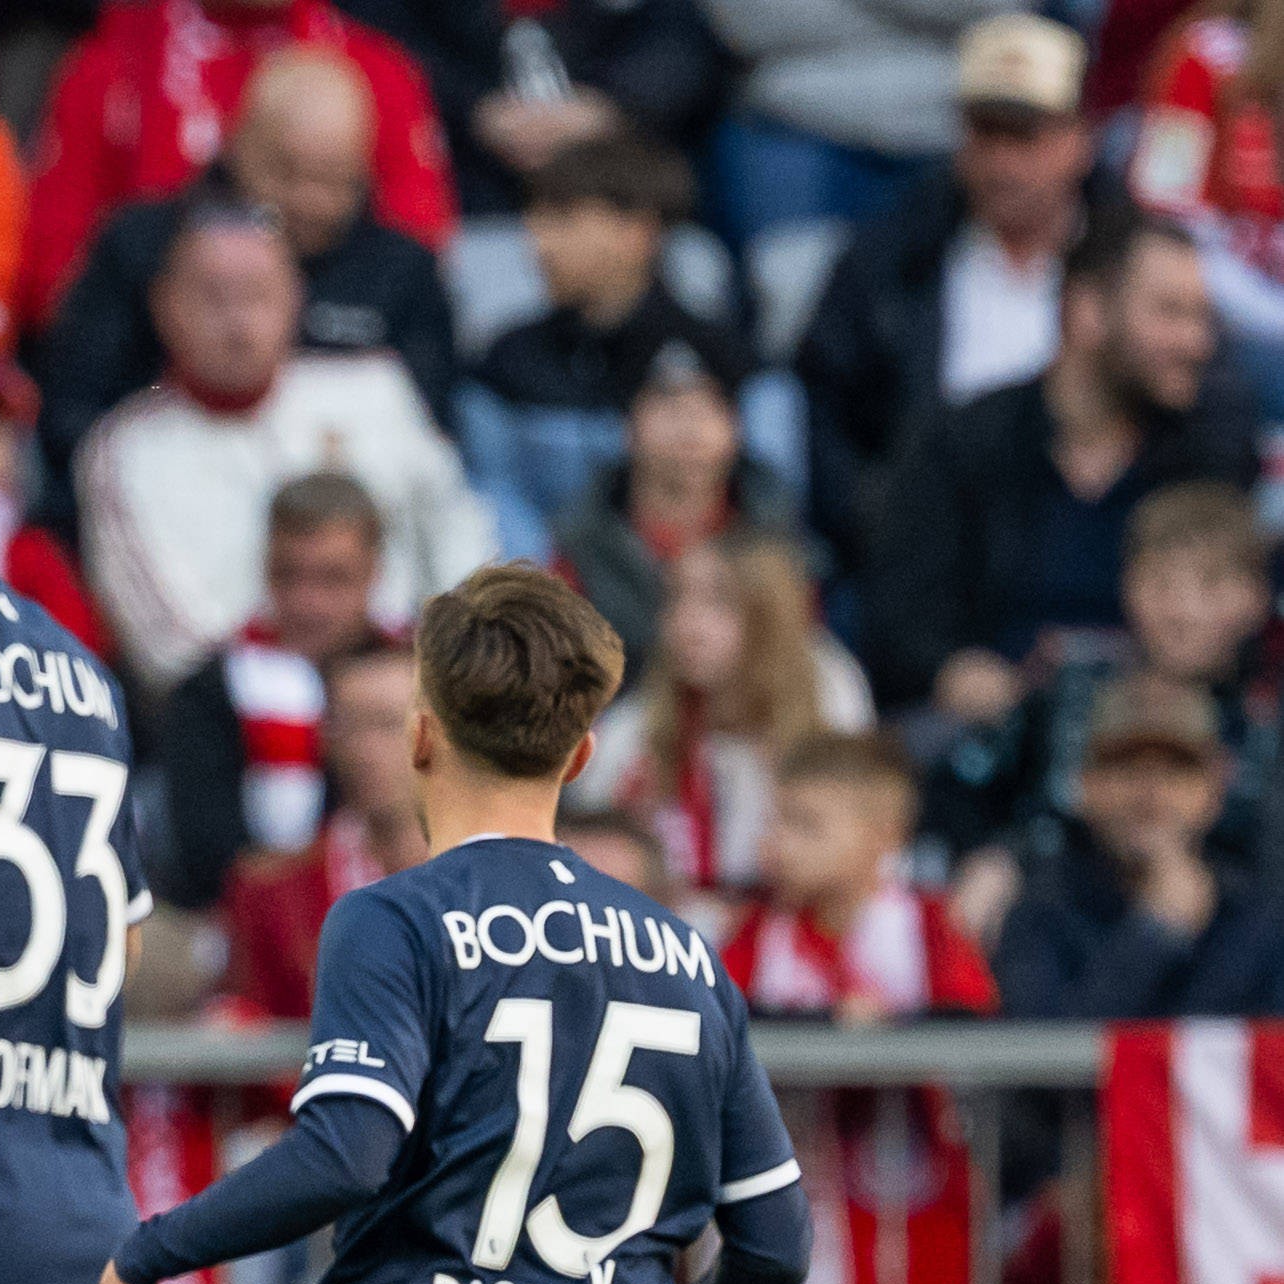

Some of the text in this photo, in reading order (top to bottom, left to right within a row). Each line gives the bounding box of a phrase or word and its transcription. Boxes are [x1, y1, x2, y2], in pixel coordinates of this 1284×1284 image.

[442, 899, 716, 988] BOCHUM
[301, 1038, 386, 1074] TEL
[471, 998, 701, 1279] 15
